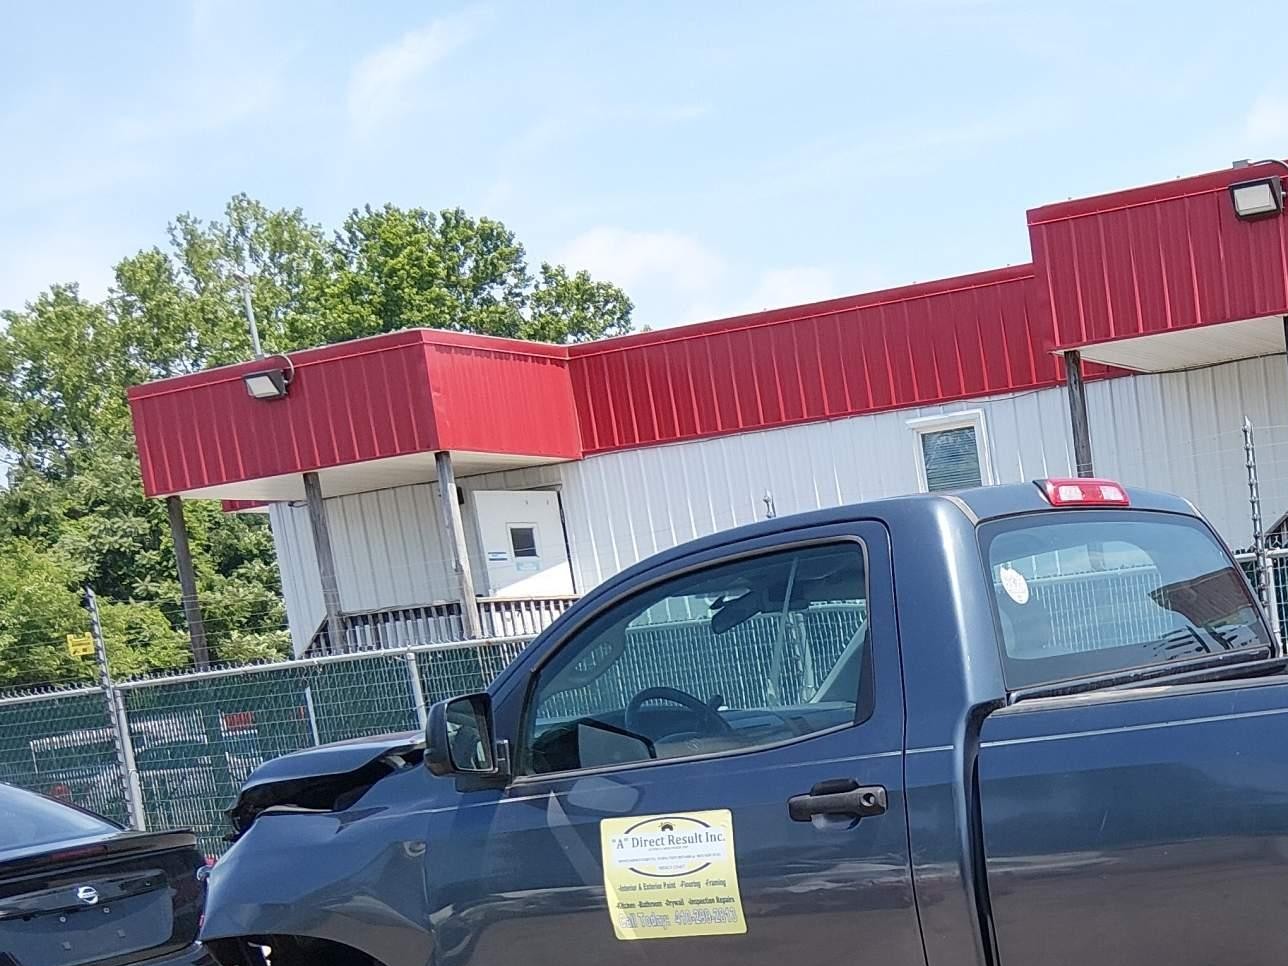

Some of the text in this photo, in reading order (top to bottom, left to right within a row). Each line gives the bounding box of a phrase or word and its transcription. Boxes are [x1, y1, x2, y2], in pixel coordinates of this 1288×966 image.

[612, 837, 628, 849] "A"
[631, 836, 665, 849] Direct
[668, 832, 703, 845] Result
[705, 831, 726, 843] Inc.
